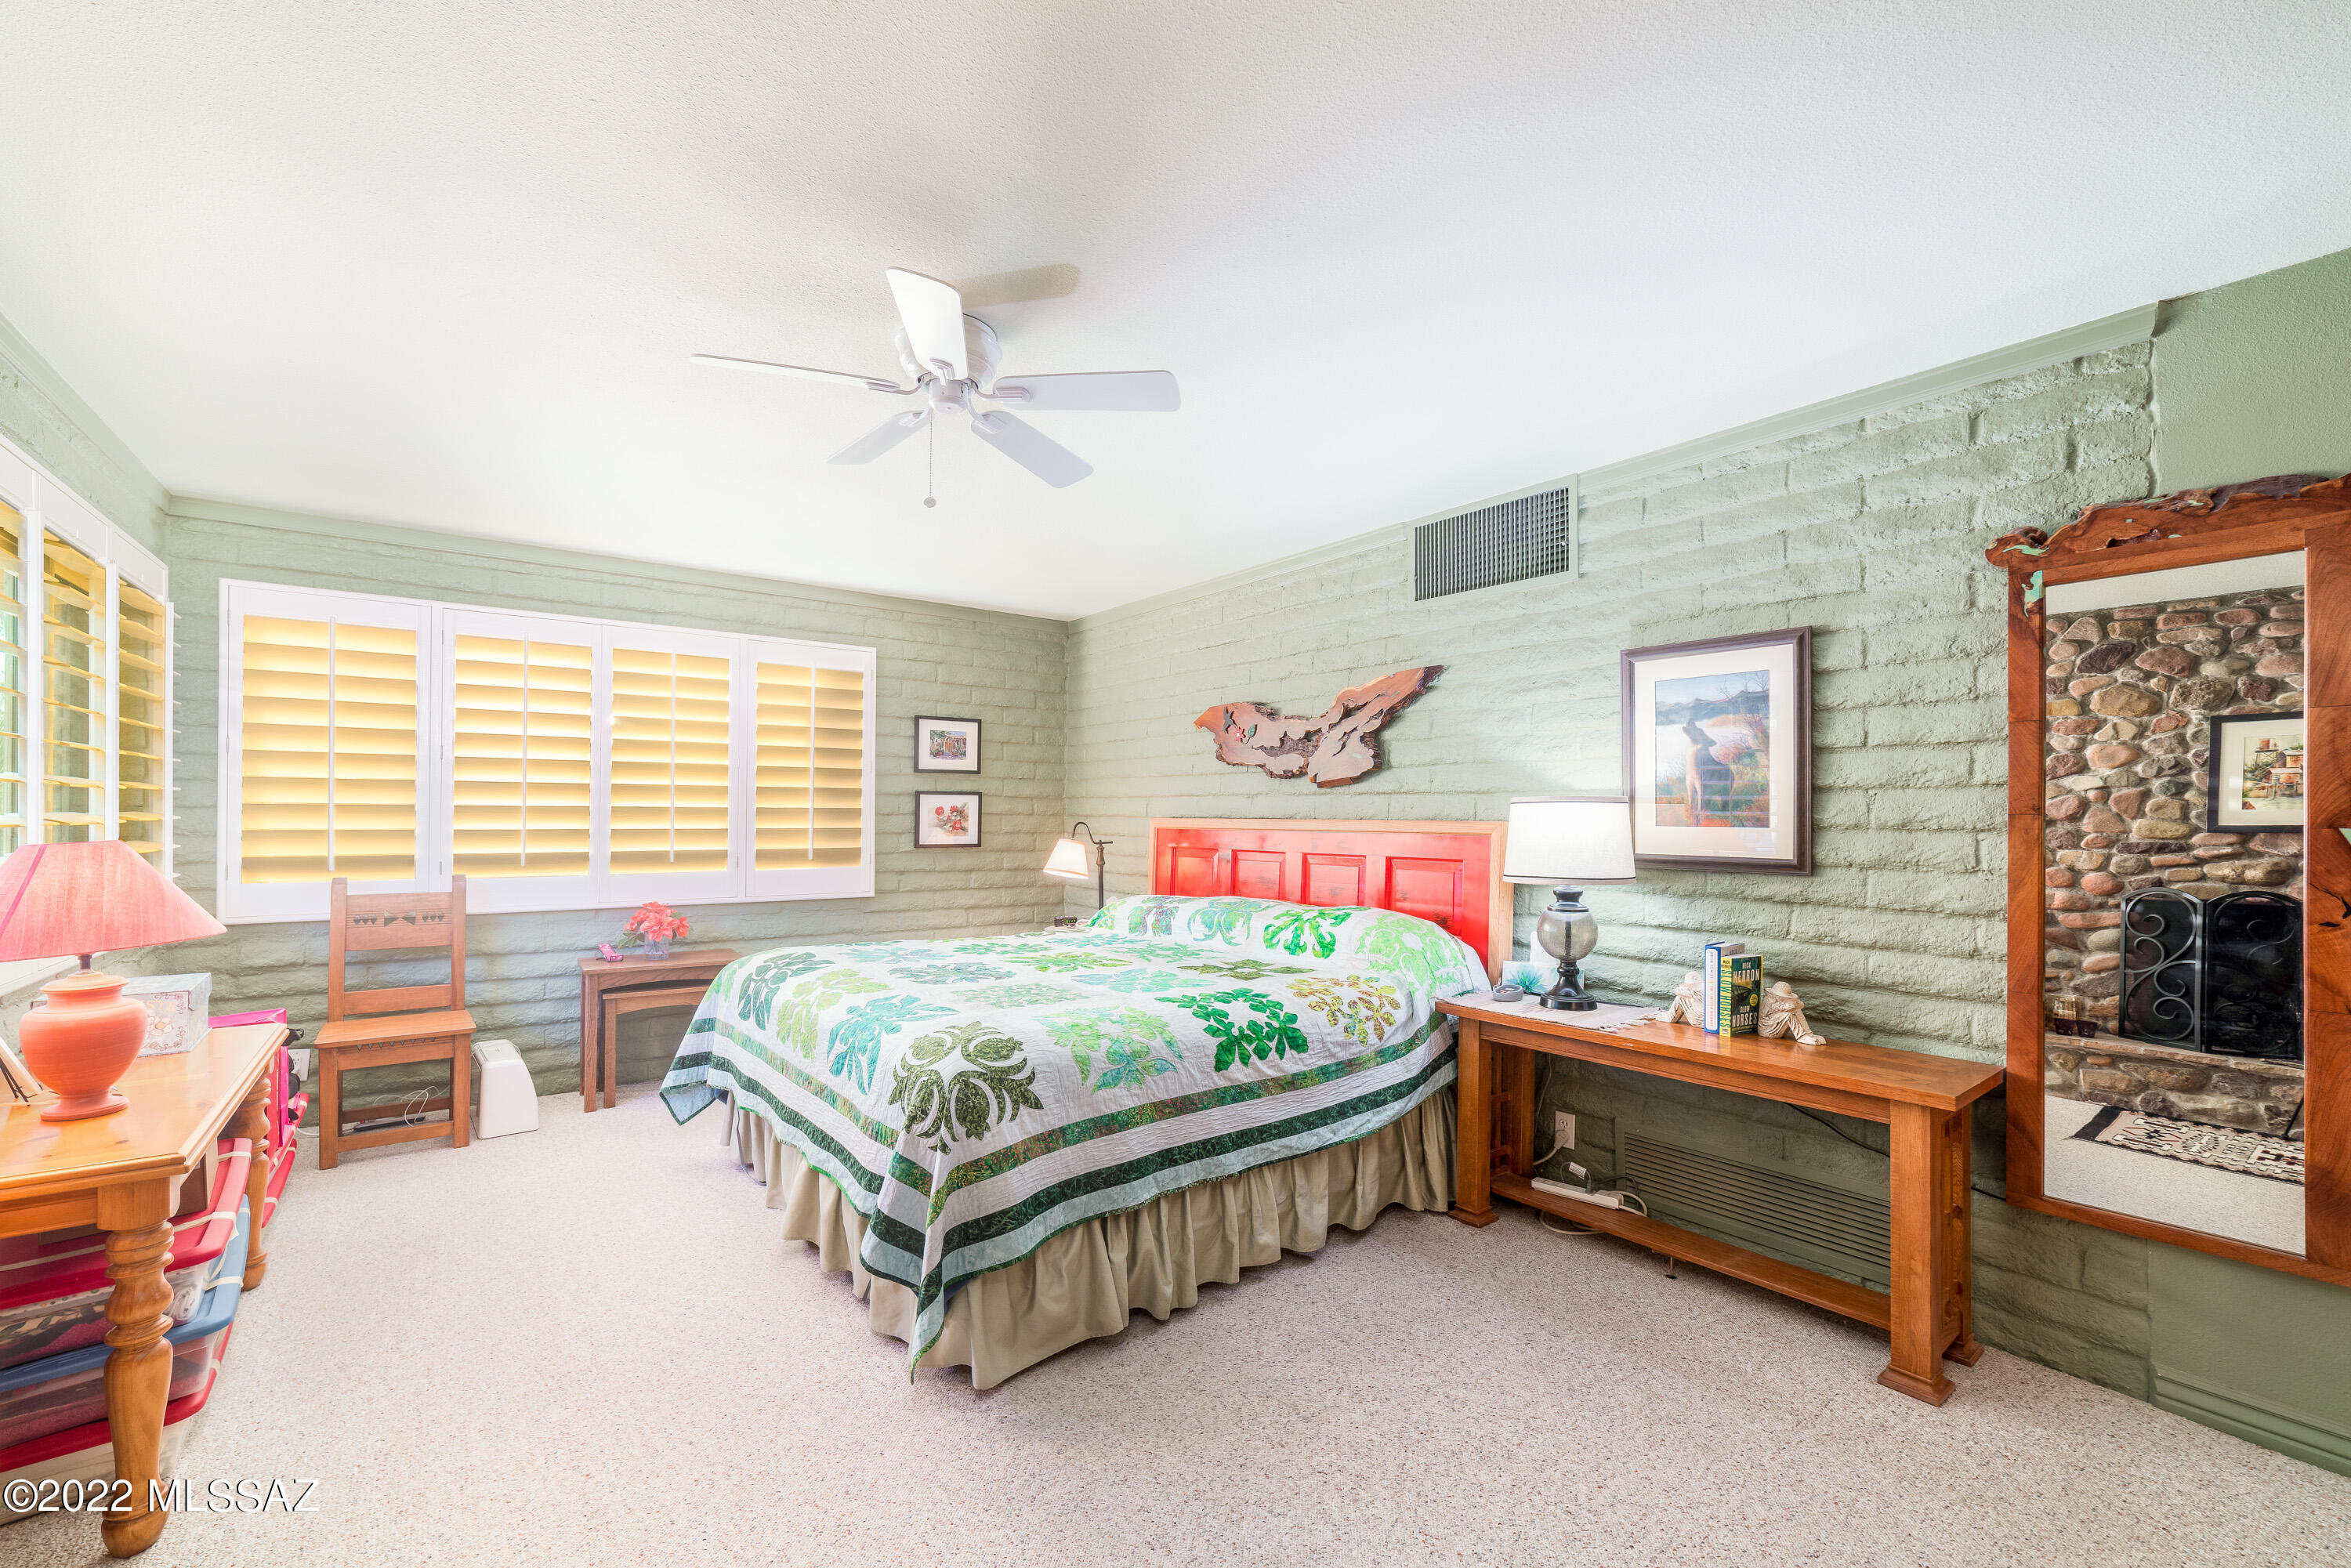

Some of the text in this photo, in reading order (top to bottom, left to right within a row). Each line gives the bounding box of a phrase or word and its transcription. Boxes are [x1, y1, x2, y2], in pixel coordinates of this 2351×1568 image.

[1720, 970, 1732, 994] SLOW
[1733, 969, 1760, 983] HERRON
[1719, 996, 1731, 1028] HORSES
[1732, 1012, 1758, 1027] HORSES
